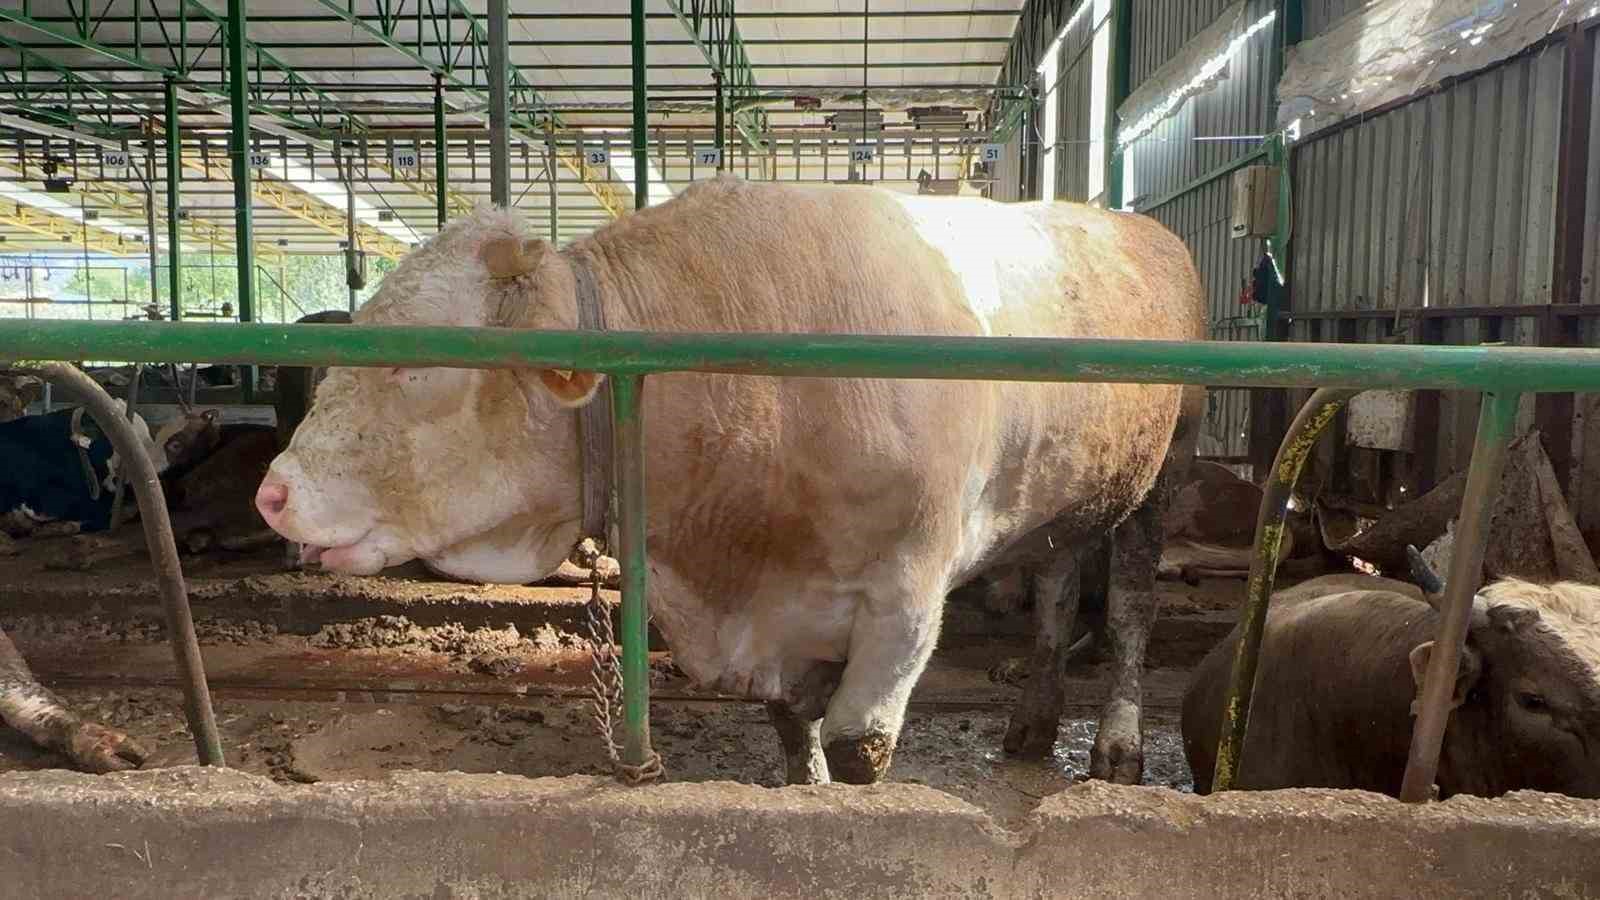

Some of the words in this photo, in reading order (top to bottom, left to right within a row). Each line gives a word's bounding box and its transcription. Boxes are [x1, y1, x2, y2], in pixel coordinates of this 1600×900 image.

[591, 153, 605, 163] 33
[852, 151, 871, 160] 124
[987, 149, 999, 158] 51
[105, 156, 125, 165] 106
[251, 156, 269, 165] 136
[399, 156, 414, 166] 118
[703, 154, 716, 163] 77
